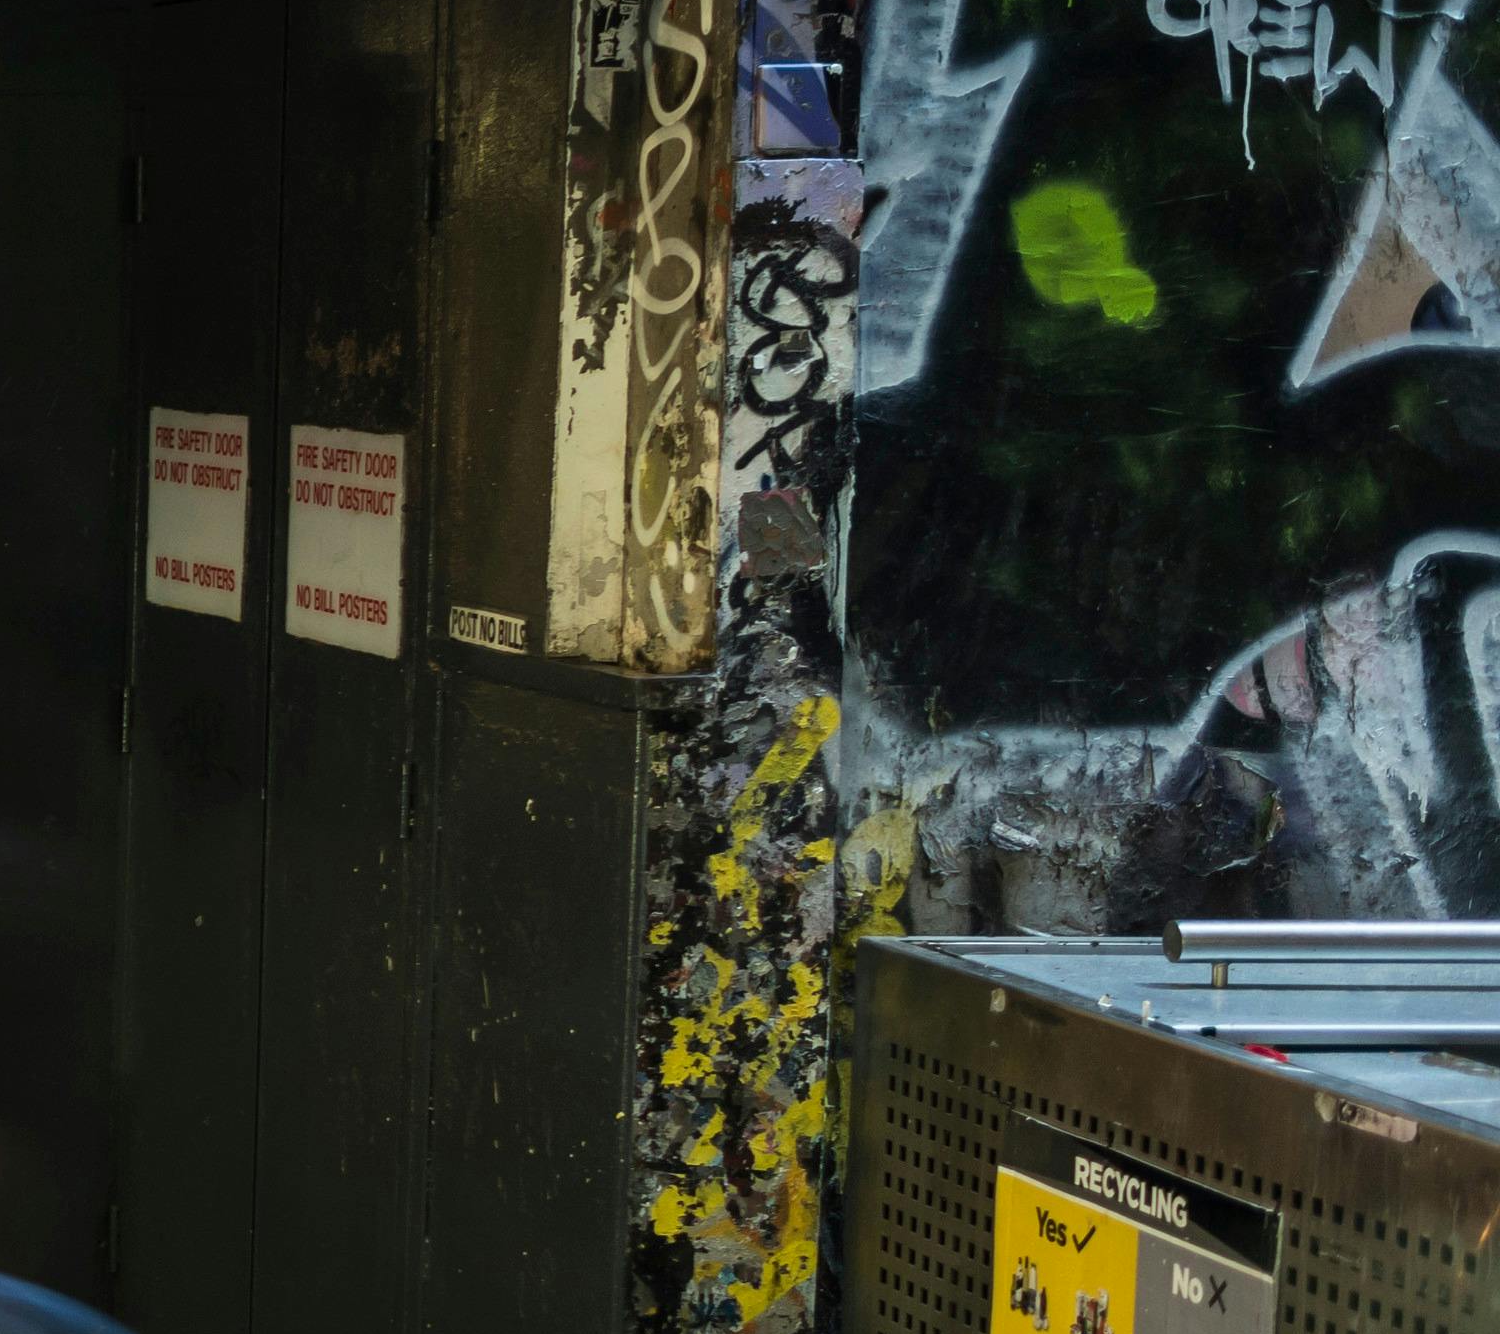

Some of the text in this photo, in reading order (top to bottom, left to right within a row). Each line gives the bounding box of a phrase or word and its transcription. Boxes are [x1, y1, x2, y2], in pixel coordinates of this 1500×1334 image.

[155, 426, 242, 458] FIRE SAFETY DOOR
[296, 443, 397, 479] FIRE SAFETY DOOR
[154, 459, 242, 492] DO NOT OBSTRUCT
[295, 479, 396, 516] DO NOT OBSTRUCT
[155, 556, 235, 592] NO BILL POSTERS
[296, 584, 387, 625] NO BILL POSTERS
[451, 607, 526, 650] POST NO BILLS
[1073, 1155, 1188, 1229] RECYCLING
[1035, 1206, 1068, 1248] Yes
[1172, 1262, 1204, 1304] No
